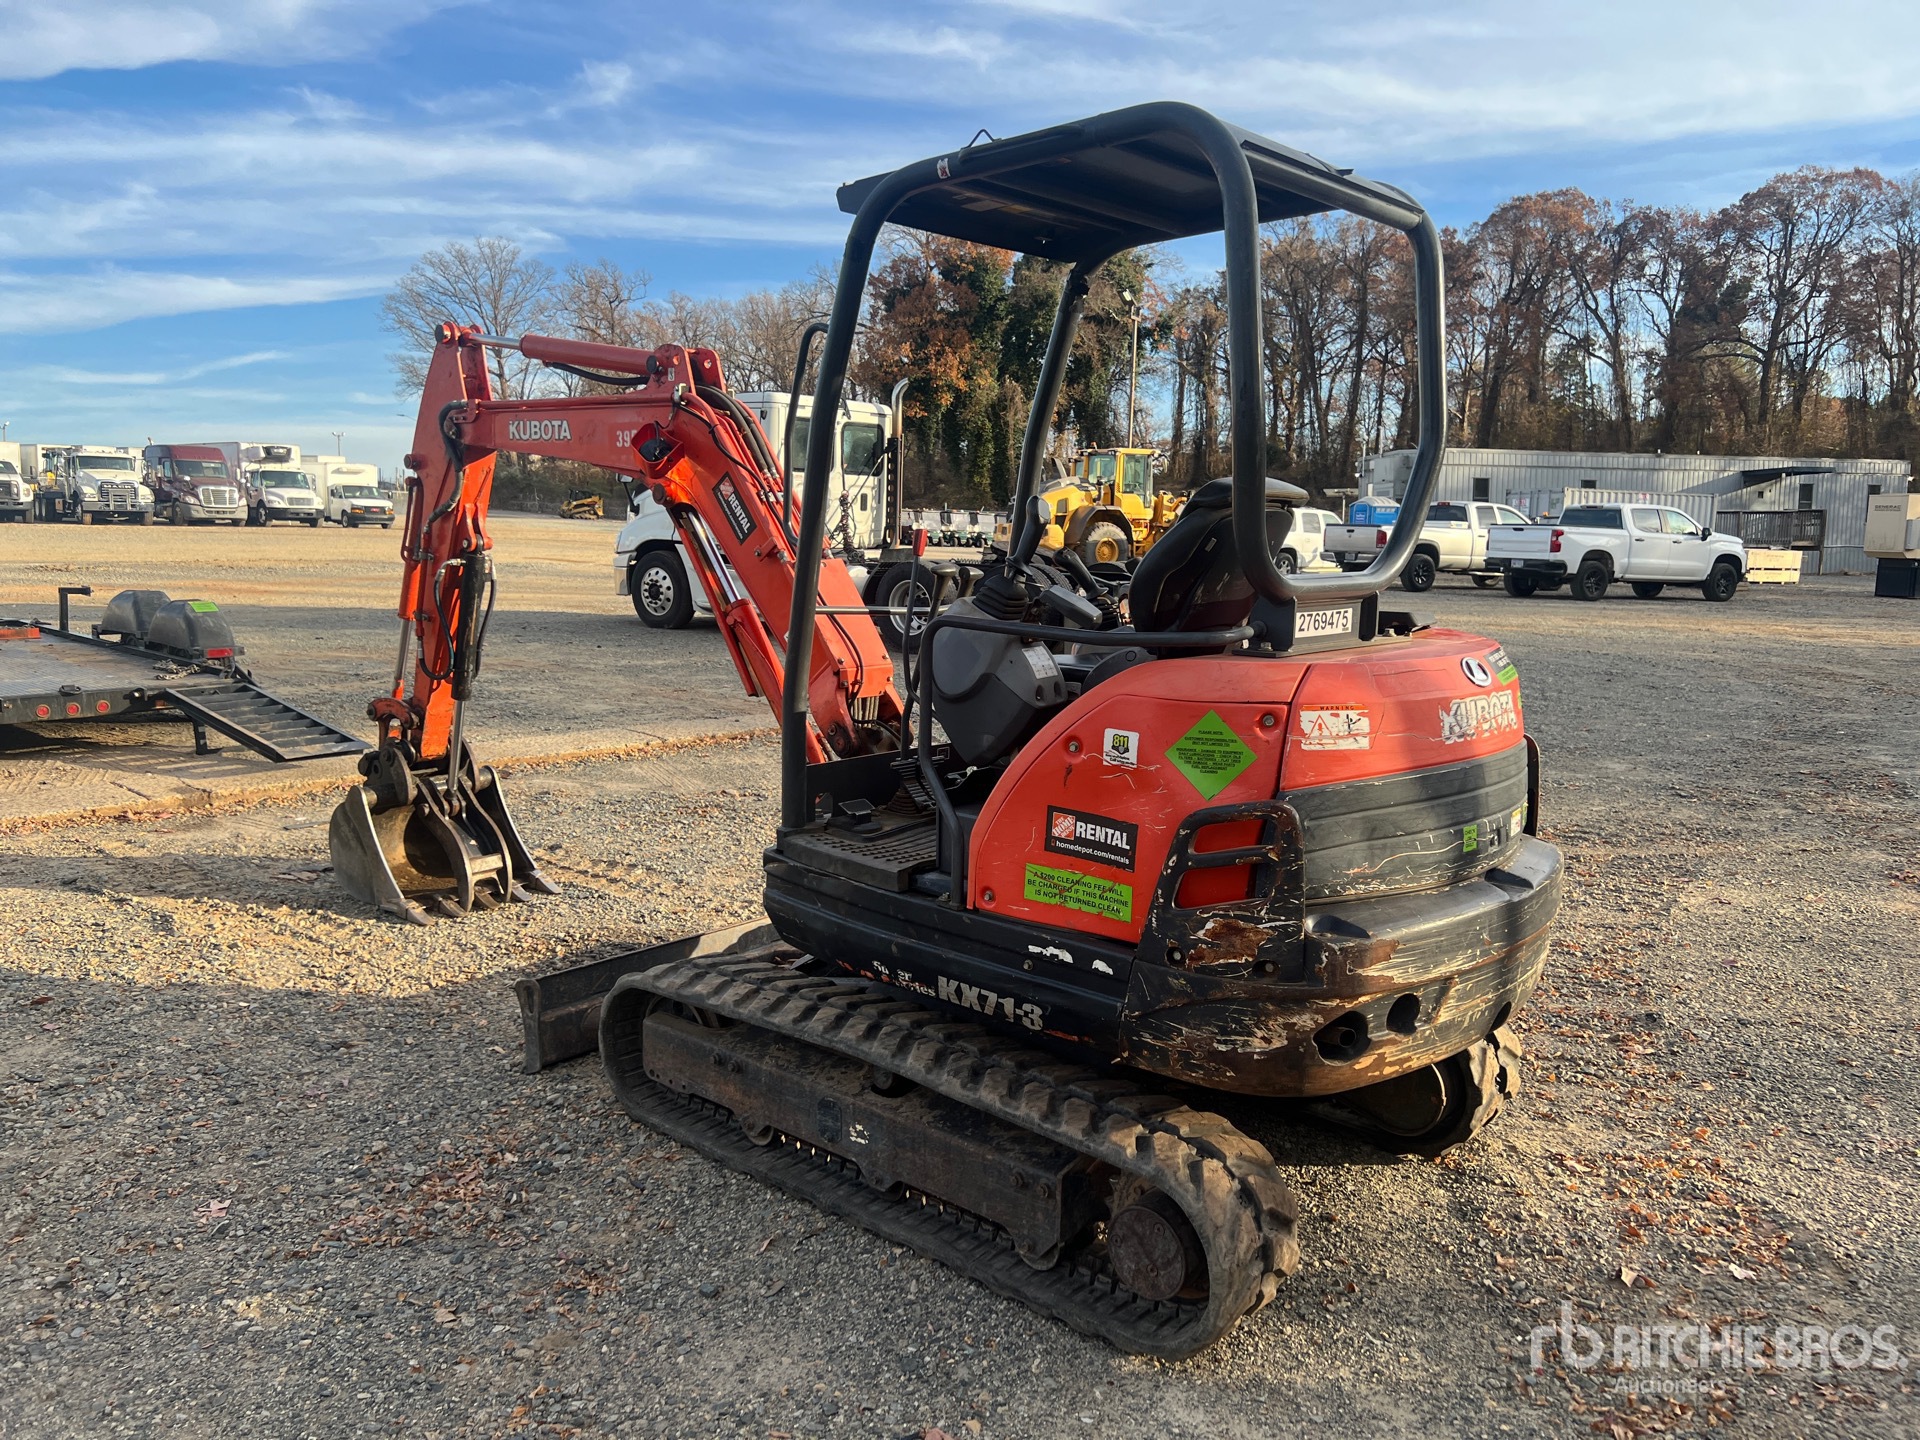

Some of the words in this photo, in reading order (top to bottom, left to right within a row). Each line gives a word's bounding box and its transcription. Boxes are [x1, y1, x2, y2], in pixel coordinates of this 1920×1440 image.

[509, 420, 572, 441] KUBOTA
[728, 493, 751, 534] RENTAL
[1298, 610, 1349, 632] 2769475
[1112, 733, 1130, 749] 811
[1052, 815, 1075, 837] HOME
[1075, 821, 1130, 850] RENTAL
[1056, 840, 1130, 865] homedepot.com/rentals
[1027, 878, 1037, 886] BE
[1038, 880, 1073, 894] CHARGED
[1081, 890, 1098, 899] THIS
[1098, 893, 1129, 908] MACHINE
[1040, 872, 1056, 881] $200
[1056, 875, 1092, 889] CLEANING
[1093, 883, 1106, 892] FEE
[1108, 888, 1124, 898] WILL
[1042, 890, 1058, 899] NOT
[1058, 894, 1097, 908] RETURNED
[937, 975, 1043, 1031] KX71-3
